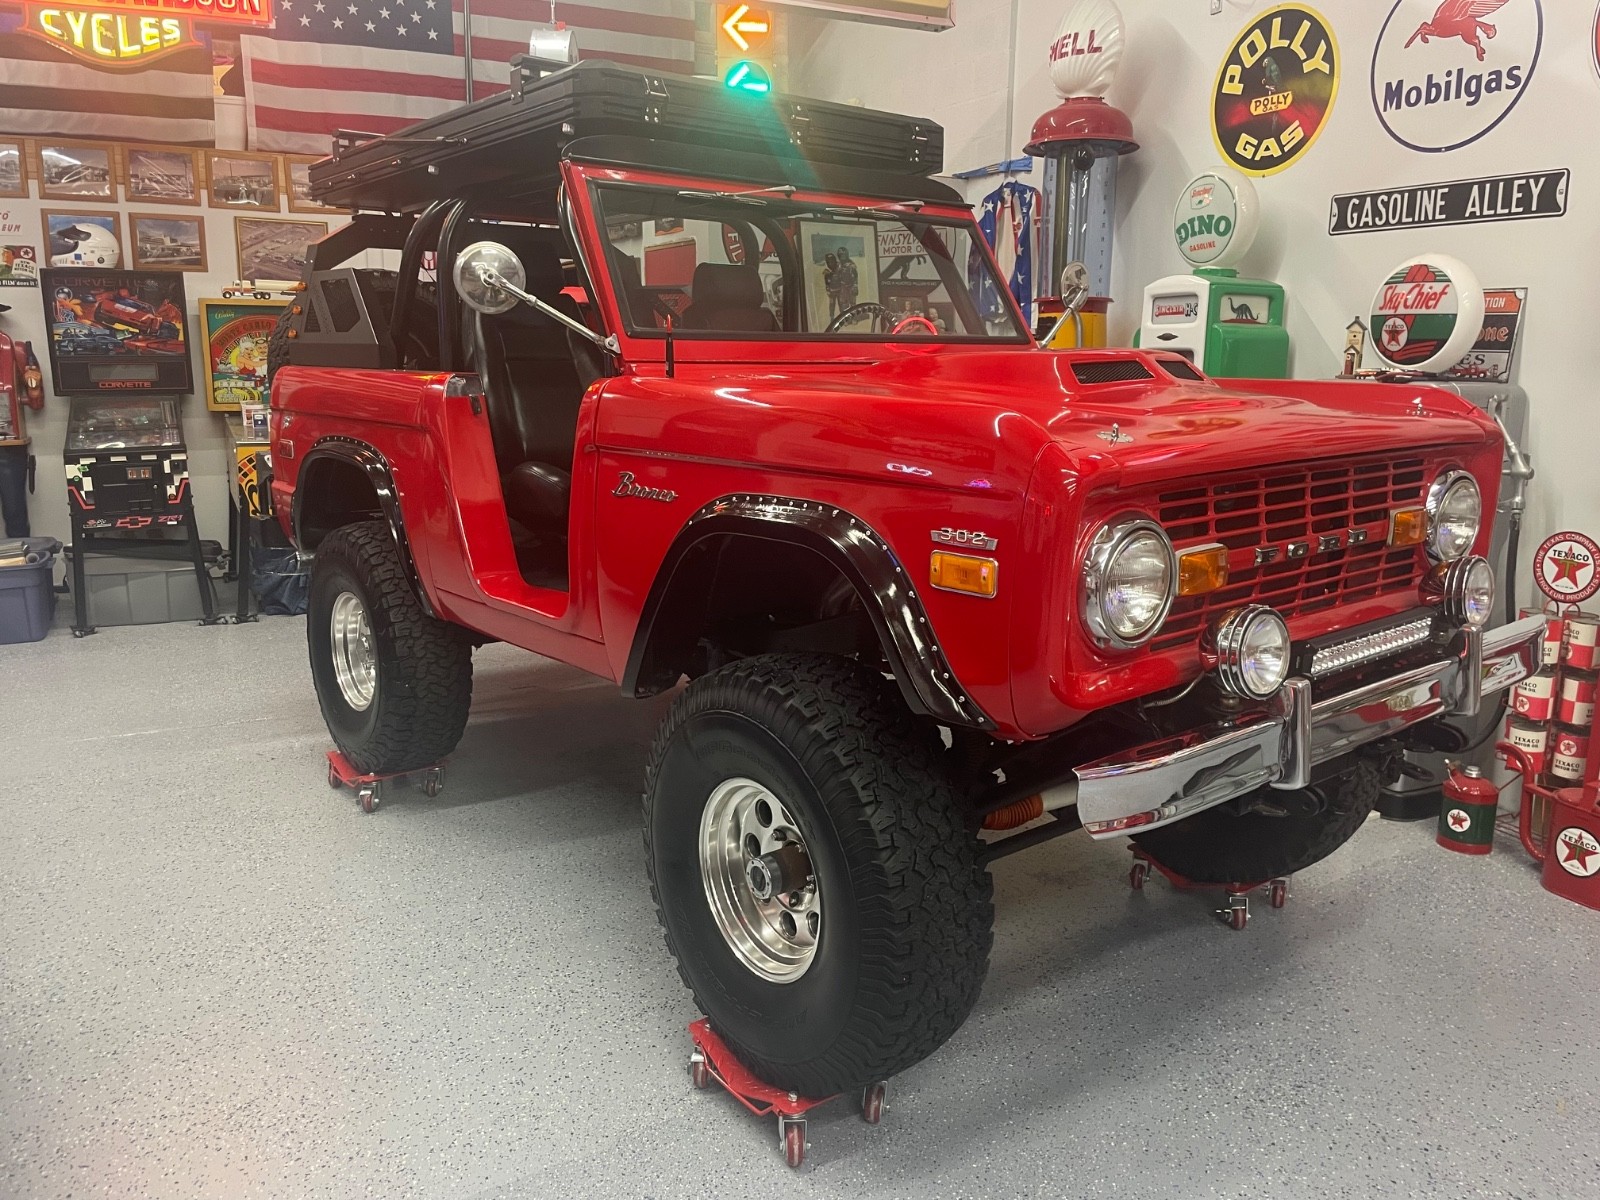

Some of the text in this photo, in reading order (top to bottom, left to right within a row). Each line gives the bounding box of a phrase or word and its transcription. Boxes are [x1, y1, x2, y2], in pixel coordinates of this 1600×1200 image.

[40, 9, 181, 58] CYCLES
[1048, 30, 1103, 64] HELL
[1222, 17, 1330, 95] POLLY
[1383, 65, 1522, 113] Mobilgas
[1254, 93, 1290, 112] POLLY
[1235, 120, 1305, 161] GAS
[1346, 177, 1547, 229] GASOLINE ALLEY
[1175, 214, 1232, 247] DINO
[883, 244, 912, 256] MOTOR
[1189, 240, 1216, 252] GASOLINE
[1378, 283, 1450, 314] Sky Chief
[1484, 297, 1506, 309] TION
[1155, 304, 1185, 317] SINCLAIR
[1460, 353, 1486, 366] ES
[99, 381, 152, 389] CORVETTE
[611, 471, 679, 502] Bronco
[940, 527, 987, 546] 302
[1543, 534, 1564, 549] TEXAS
[1253, 528, 1368, 567] FORD
[1552, 549, 1590, 562] TEXACO
[1566, 578, 1599, 601] PRODUCTS
[1514, 736, 1540, 744] TEXACO
[1555, 759, 1580, 769] TEXACO
[1563, 833, 1598, 851] TEXACO
